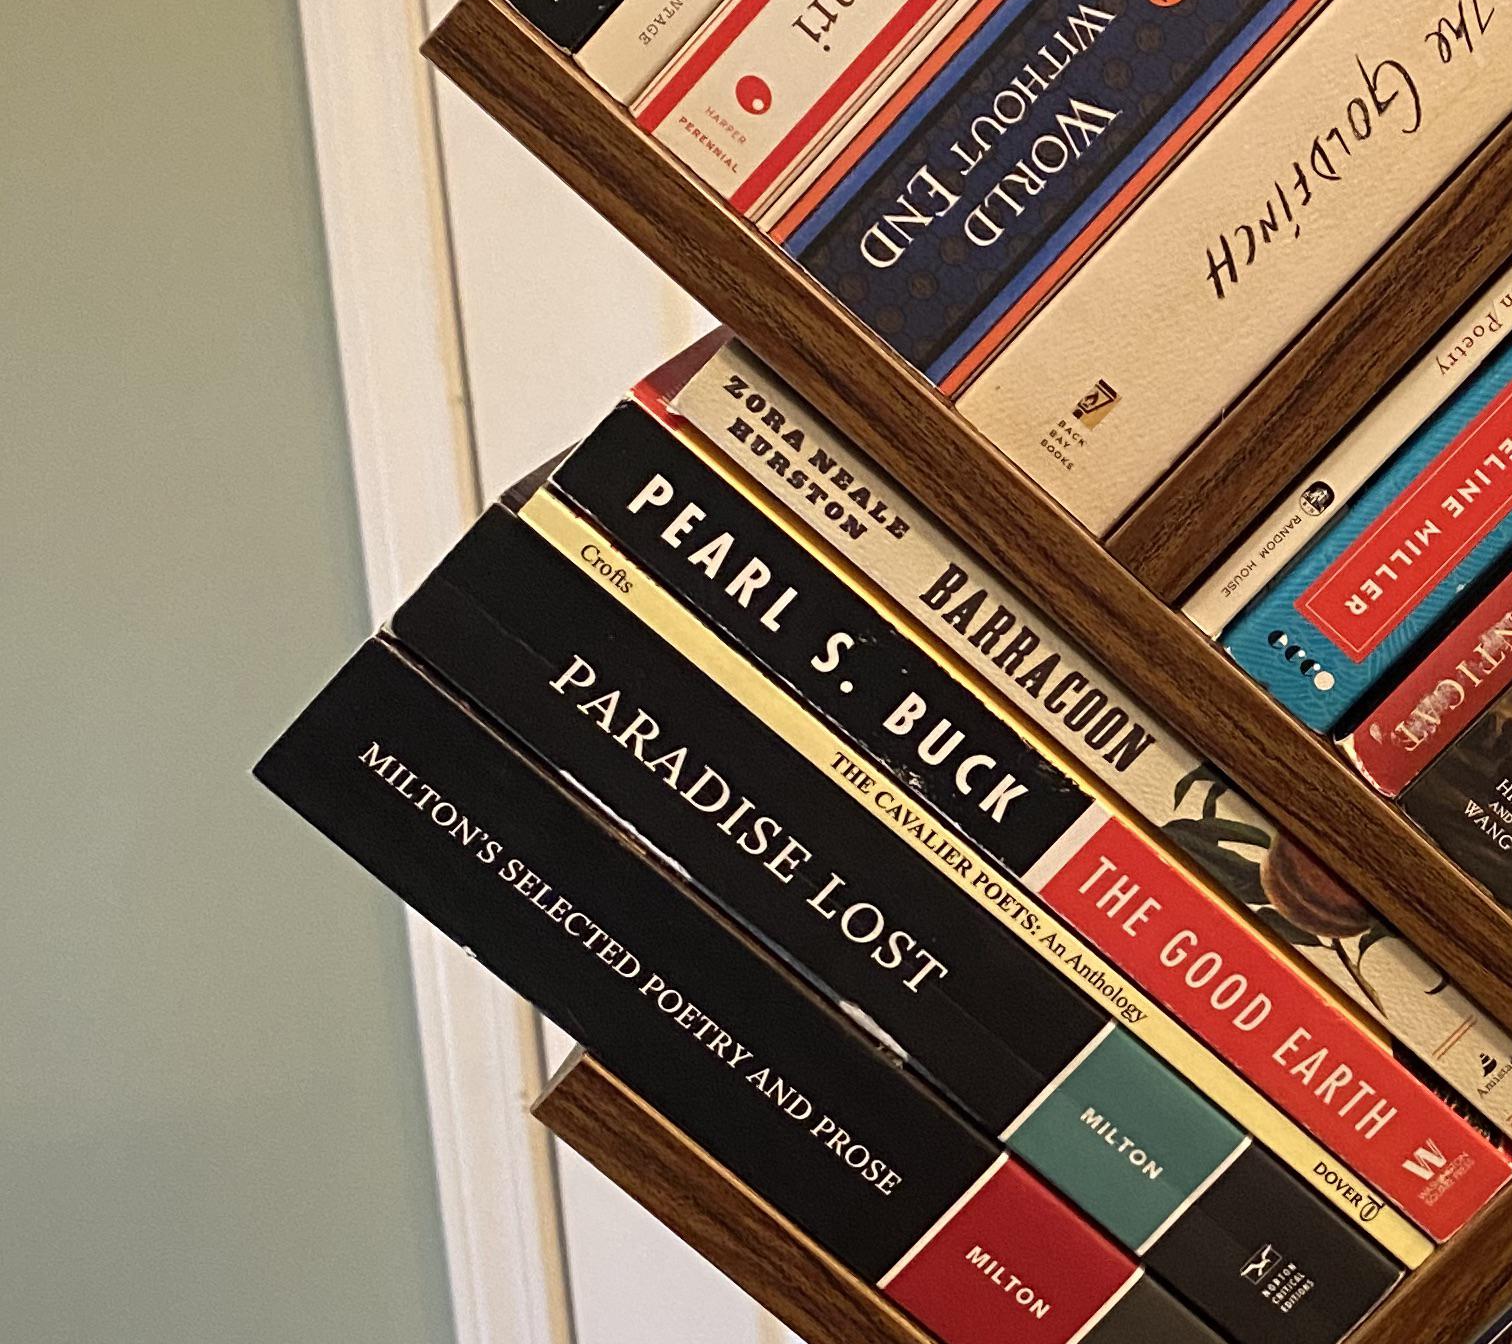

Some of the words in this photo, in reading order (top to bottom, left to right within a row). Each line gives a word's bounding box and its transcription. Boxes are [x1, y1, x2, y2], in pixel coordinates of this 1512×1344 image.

[704, 106, 747, 145] HARPER
[950, 4, 1116, 176] WITHOUT
[678, 116, 738, 174] PERENNIAL
[964, 98, 1117, 247] WORLD
[860, 164, 961, 268] END
[1435, 313, 1503, 375] Poetry
[722, 375, 805, 453] ZORA
[807, 448, 911, 540] NEALE
[1040, 438, 1074, 471] BOOKS
[1048, 429, 1071, 448] BAY
[1057, 419, 1085, 447] BACK
[726, 416, 868, 540] HURSTON
[580, 544, 633, 594] Crofts
[1259, 514, 1302, 559] RANDOM
[1344, 519, 1442, 615] MILLER
[1220, 560, 1257, 598] HOUSE
[626, 473, 798, 632] PEARL
[810, 632, 855, 694] S.
[882, 691, 1029, 824] BUCK
[918, 562, 1158, 773] BARRACOON
[548, 654, 813, 884] PARADISE
[806, 872, 949, 993] LOST
[831, 751, 876, 795] THE
[874, 791, 973, 878] CAVALIER
[972, 870, 1041, 936] POETS:
[1039, 933, 1066, 958] An
[1064, 954, 1148, 1024] Anthology
[358, 741, 503, 864] MILTON'S
[498, 859, 641, 978] SELECTED
[638, 972, 754, 1069] POETRY
[745, 1067, 812, 1120] AND
[809, 1115, 903, 1196] PROSE
[1078, 855, 1162, 937] THE
[1159, 930, 1272, 1031] GOOD
[1271, 1027, 1398, 1140] EARTH
[1080, 1107, 1164, 1180] MILTON
[1312, 1161, 1363, 1208] DOVER
[965, 1245, 1050, 1319] MILTON
[1261, 1263, 1297, 1298] NORTON
[1271, 1272, 1306, 1305] CRITICAL
[1280, 1279, 1314, 1313] EDITIONS
